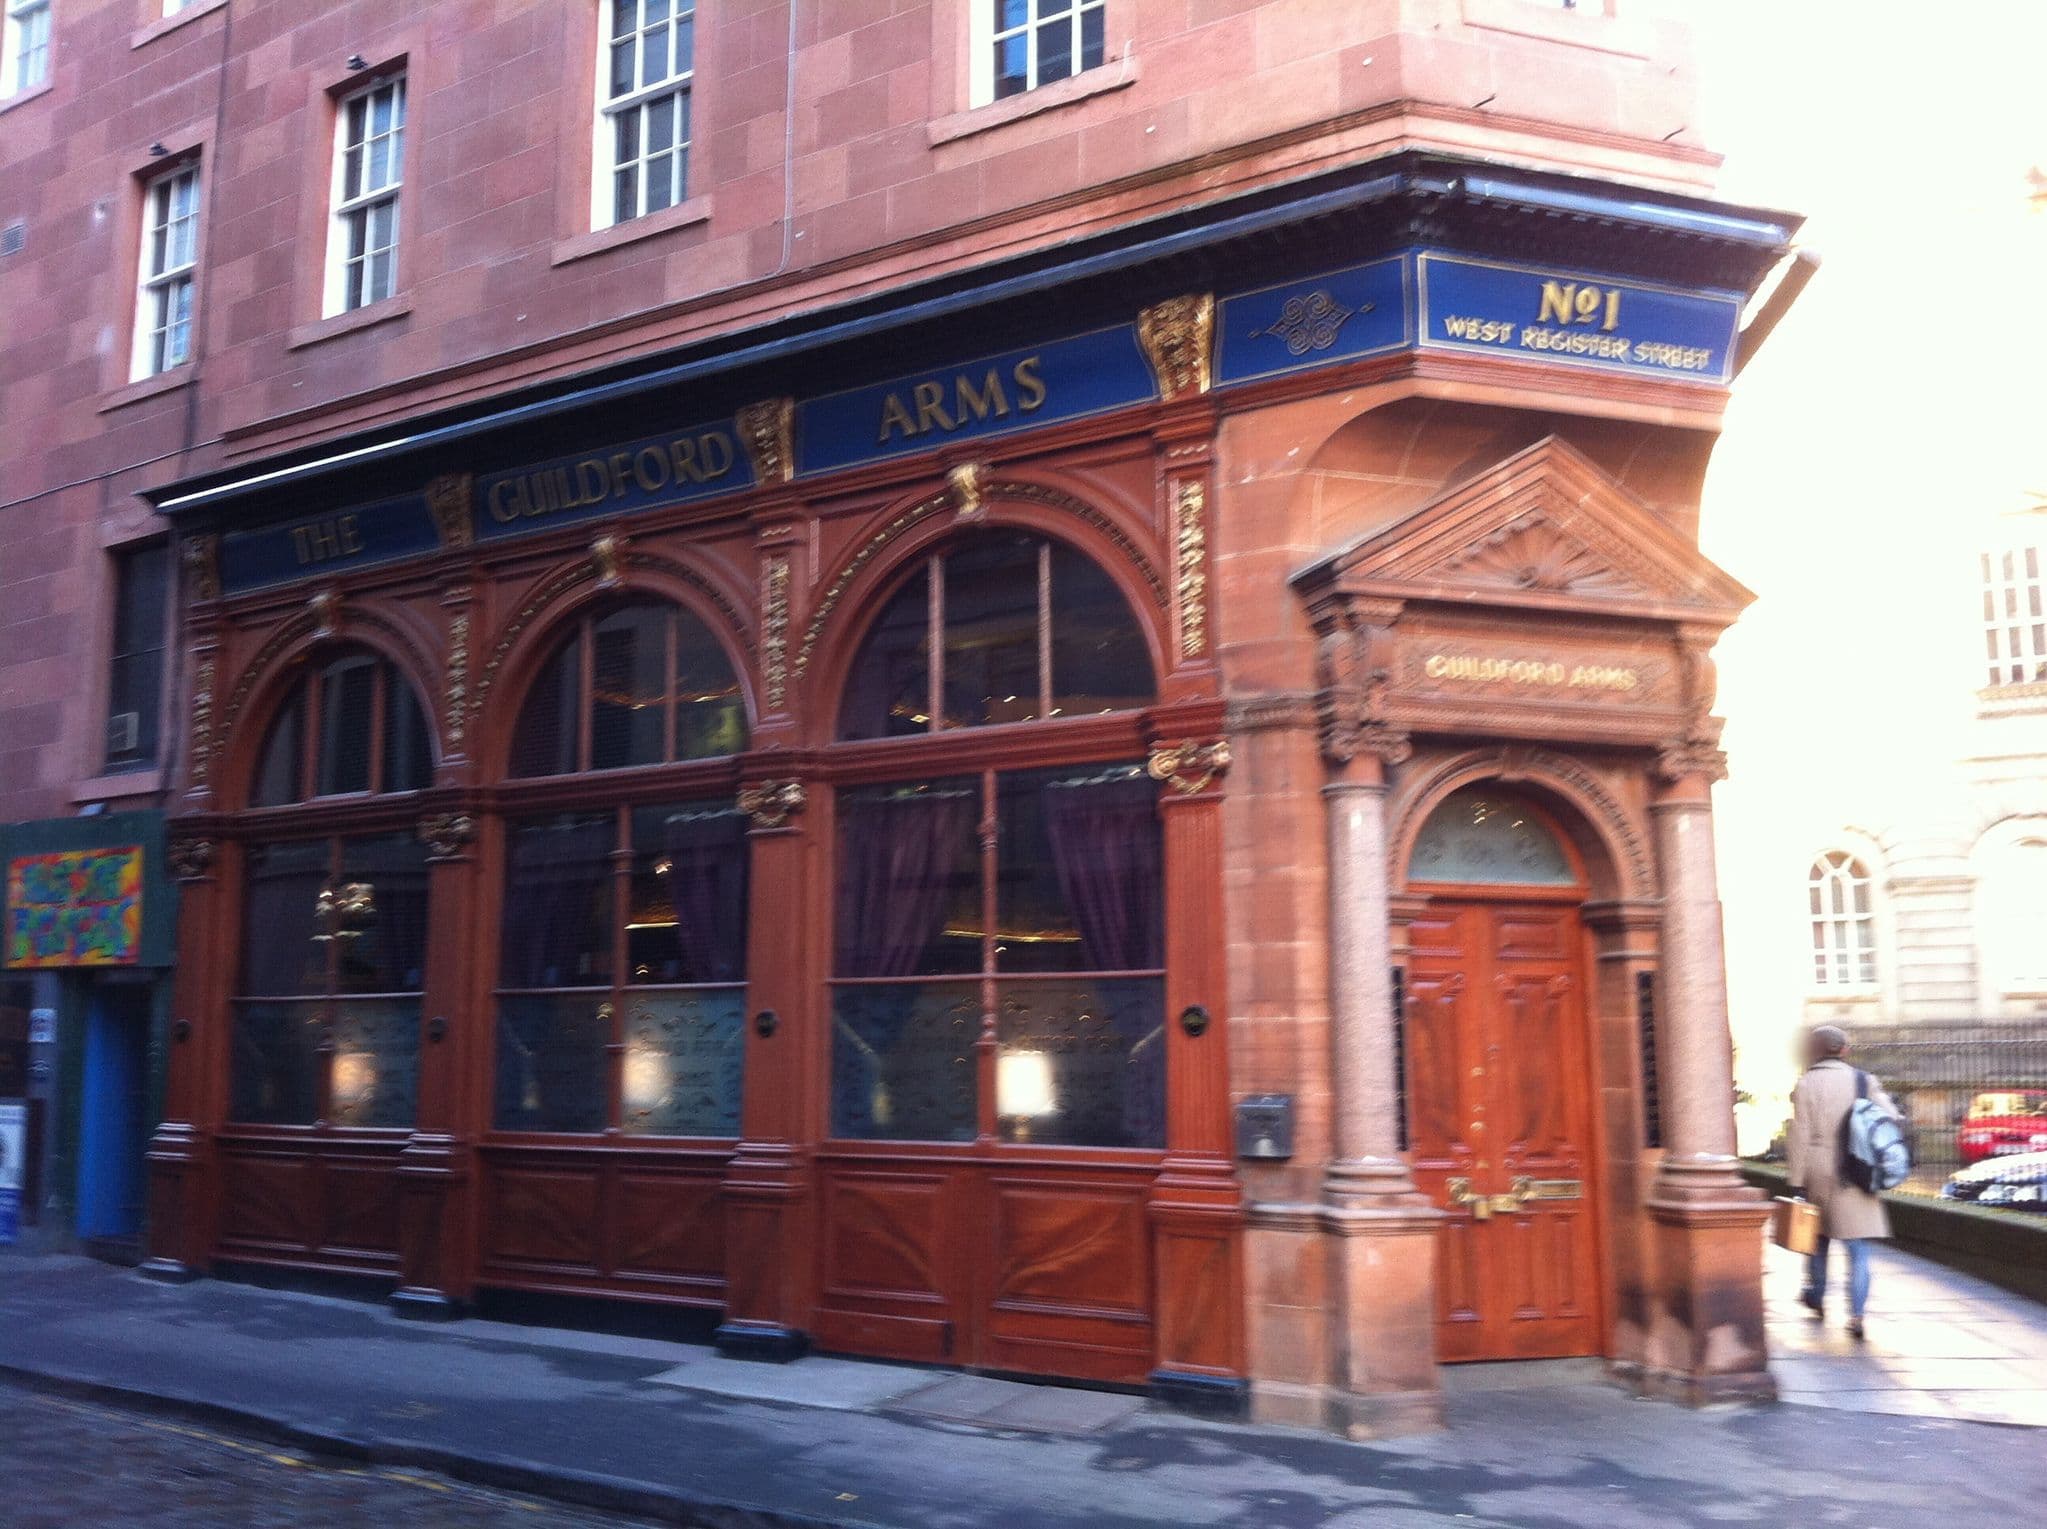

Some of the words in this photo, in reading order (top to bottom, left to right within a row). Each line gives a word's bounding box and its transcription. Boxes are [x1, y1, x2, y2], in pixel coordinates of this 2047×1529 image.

[1444, 315, 1514, 344] WEST
[1520, 325, 1632, 365] REGISTER
[1632, 341, 1713, 370] STREET
[289, 514, 366, 565] THE
[488, 431, 734, 523] GUILDFORD
[878, 355, 1047, 443] ARMS
[1425, 655, 1565, 686] GUILDFORD
[1567, 664, 1637, 691] ARMS
